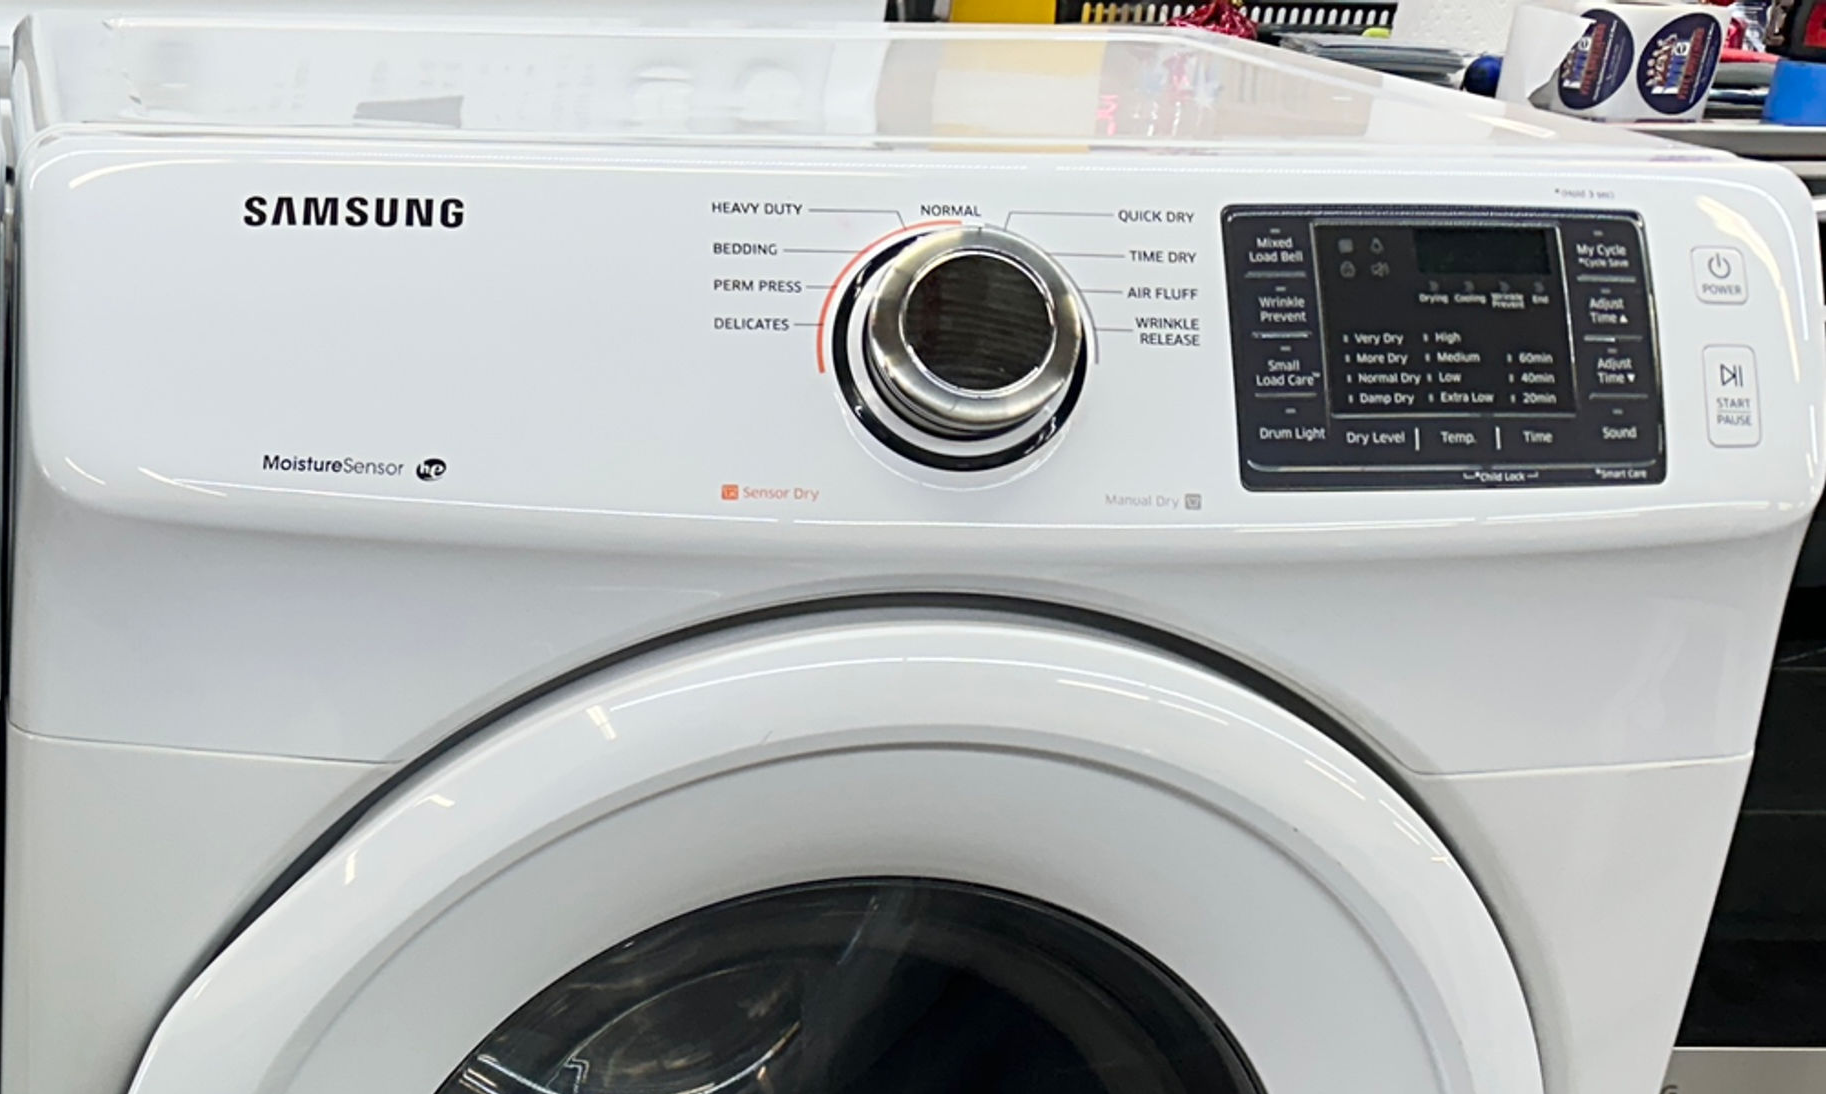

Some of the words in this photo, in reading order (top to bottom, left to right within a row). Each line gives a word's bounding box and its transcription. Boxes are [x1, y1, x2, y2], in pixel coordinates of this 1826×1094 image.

[243, 196, 464, 228] SAMSUNG
[712, 202, 759, 214] HEAVY
[764, 203, 803, 215] DUTY
[920, 204, 981, 217] NORMAL
[1118, 210, 1163, 223] QUICK
[1167, 211, 1194, 223] DRY
[713, 243, 777, 255] BEDDING
[1256, 237, 1293, 248] Mixed
[1129, 250, 1164, 262] TIME
[1168, 252, 1197, 263] DRY
[1249, 251, 1278, 262] Load
[1281, 251, 1303, 262] Bell
[1576, 244, 1594, 256] My
[1597, 244, 1627, 257] Cycle
[1608, 258, 1629, 268] Save
[713, 279, 754, 291] PERM
[759, 280, 802, 293] PRESS
[1702, 283, 1741, 295] POWER
[1127, 287, 1151, 299] AIR
[1156, 288, 1198, 300] FLUFF
[1454, 293, 1487, 304] Cooling
[1258, 295, 1305, 308] Wrinkle
[1589, 297, 1624, 311] Adjust
[1260, 310, 1307, 323] Prevent
[1590, 311, 1617, 324] Time
[714, 317, 790, 331] DELICATES
[1135, 317, 1200, 331] WRINKLE
[1140, 333, 1200, 346] RELEASE
[1355, 333, 1381, 346] Very
[1383, 333, 1404, 346] Dry
[1435, 332, 1461, 344] High
[1356, 353, 1384, 364] More
[1387, 353, 1408, 366] Dry
[1436, 352, 1481, 363] Medium
[1518, 352, 1553, 364] 60min
[1597, 357, 1633, 371] Adjust
[1267, 360, 1300, 372] Small
[1256, 374, 1285, 386] Load
[1358, 373, 1398, 384] Normal
[1400, 373, 1421, 386] Dry
[1438, 372, 1462, 383] Low
[1521, 373, 1555, 383] 40min
[1597, 372, 1625, 384] Time
[1359, 393, 1391, 405] Damp
[1394, 393, 1414, 405] Dry
[1440, 392, 1470, 403] Extra
[1471, 392, 1494, 403] Low
[1523, 392, 1557, 404] 20min
[1716, 398, 1750, 409] START
[1716, 414, 1752, 426] PAUSE
[1259, 427, 1292, 440] Drum
[1295, 427, 1326, 441] Light
[1346, 431, 1369, 445] Dry
[1372, 431, 1405, 443] Level
[1440, 431, 1477, 444] Temp.
[1523, 431, 1553, 443] Time
[1602, 426, 1637, 439] Sound
[262, 455, 404, 476] MoistureSensor
[1504, 471, 1525, 482] Lock
[1628, 469, 1647, 479] Care
[743, 486, 789, 500] Sensor
[794, 487, 819, 502] Dry
[1105, 494, 1151, 507] Manual
[1156, 495, 1179, 509] Dry
